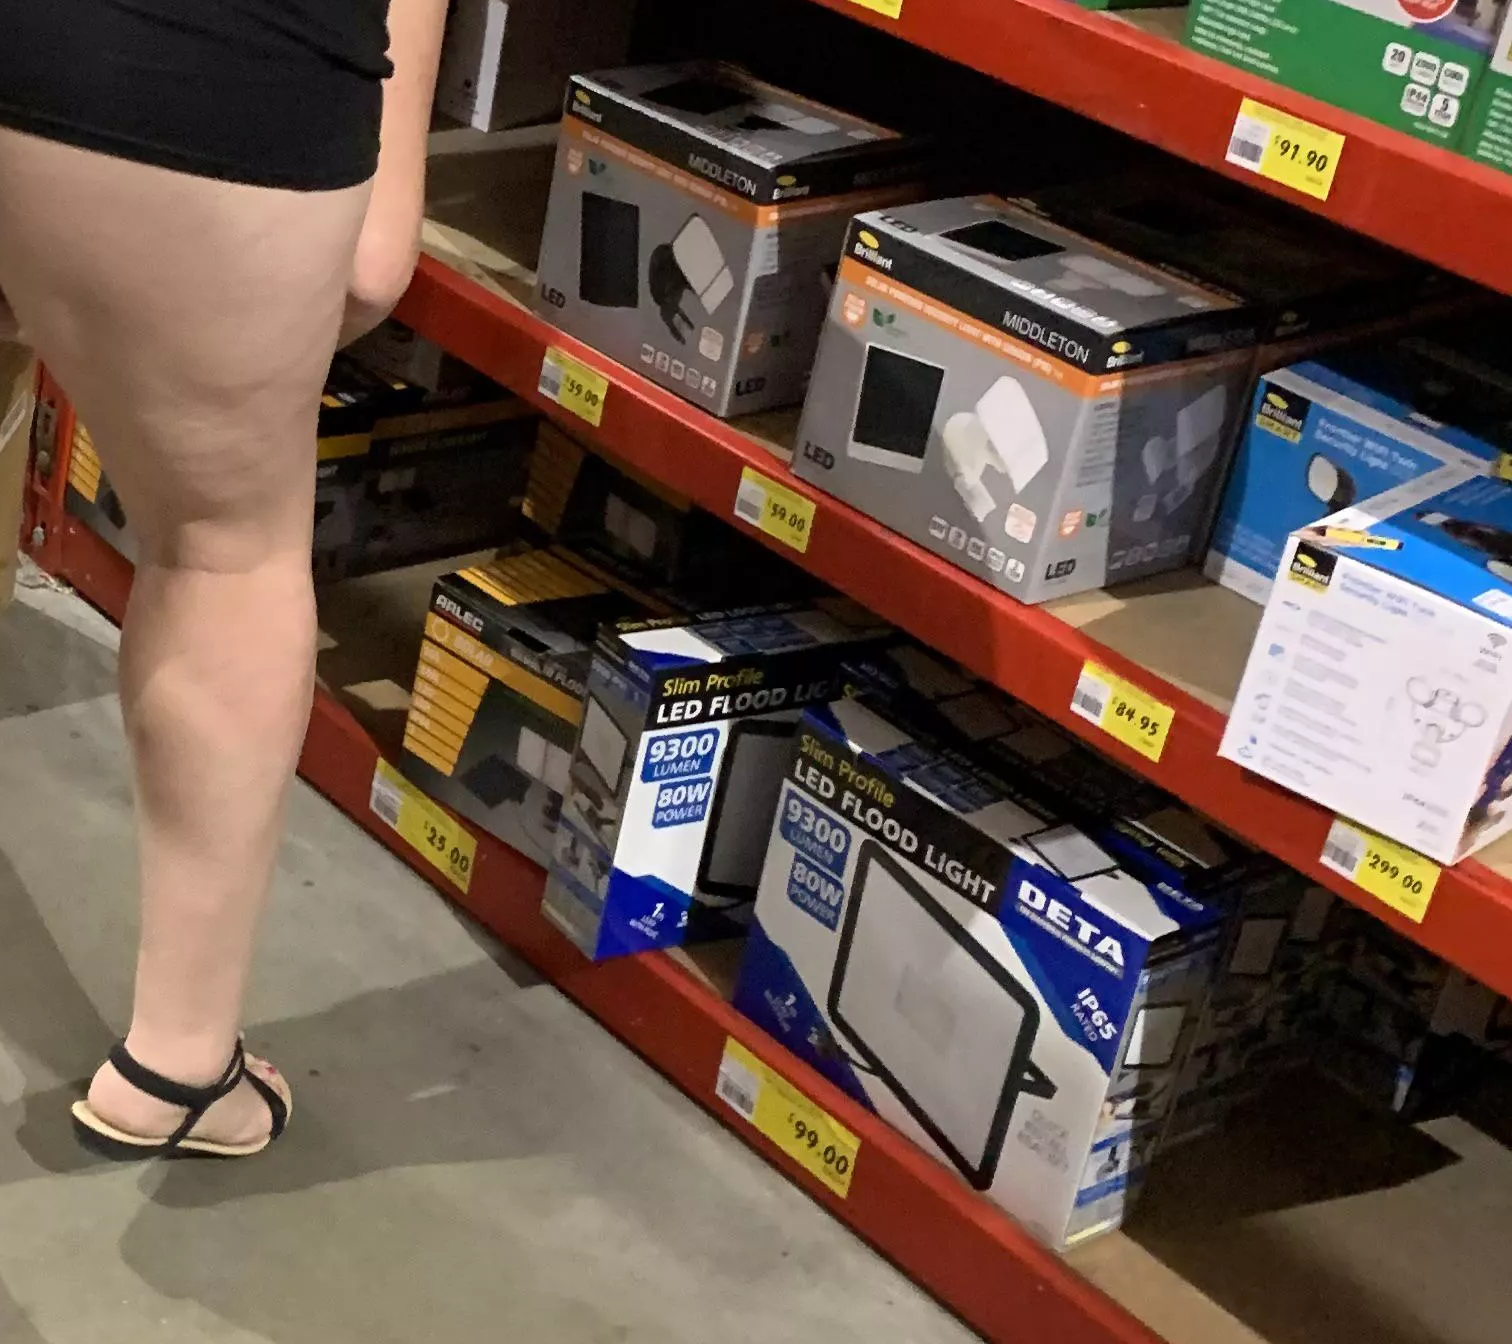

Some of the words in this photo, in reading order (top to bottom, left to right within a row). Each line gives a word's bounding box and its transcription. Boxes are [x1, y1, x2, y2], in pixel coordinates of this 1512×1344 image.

[1390, 48, 1406, 64] 20
[1272, 134, 1329, 174] $91.90
[688, 153, 758, 197] MIDDLETON
[853, 242, 893, 270] Brilliant
[542, 283, 566, 308] LED
[1001, 310, 1090, 364] MIDDLETON
[803, 440, 836, 471] LED
[1044, 558, 1077, 581] LED
[662, 678, 702, 697] Slim
[705, 669, 765, 693] Profile
[656, 698, 703, 724] LED
[708, 687, 788, 718] FLOOD
[1111, 695, 1160, 737] $84.95
[650, 732, 715, 764] 9300
[653, 759, 701, 778] LUMEN
[800, 734, 835, 771] Slim
[838, 759, 897, 809] Profile
[656, 804, 703, 824] POWER
[658, 781, 710, 809] 80W
[423, 818, 469, 873] $25.00
[786, 798, 846, 854] 9300
[793, 758, 836, 799] LED
[839, 792, 919, 854] FLOOD
[923, 844, 996, 904] LIGHT
[791, 861, 843, 907] 80W
[1366, 849, 1424, 896] $299.00
[1017, 879, 1125, 967] DETA
[1069, 1002, 1099, 1043] RATED
[1077, 987, 1118, 1041] IP65
[788, 1111, 850, 1176] $99.00
